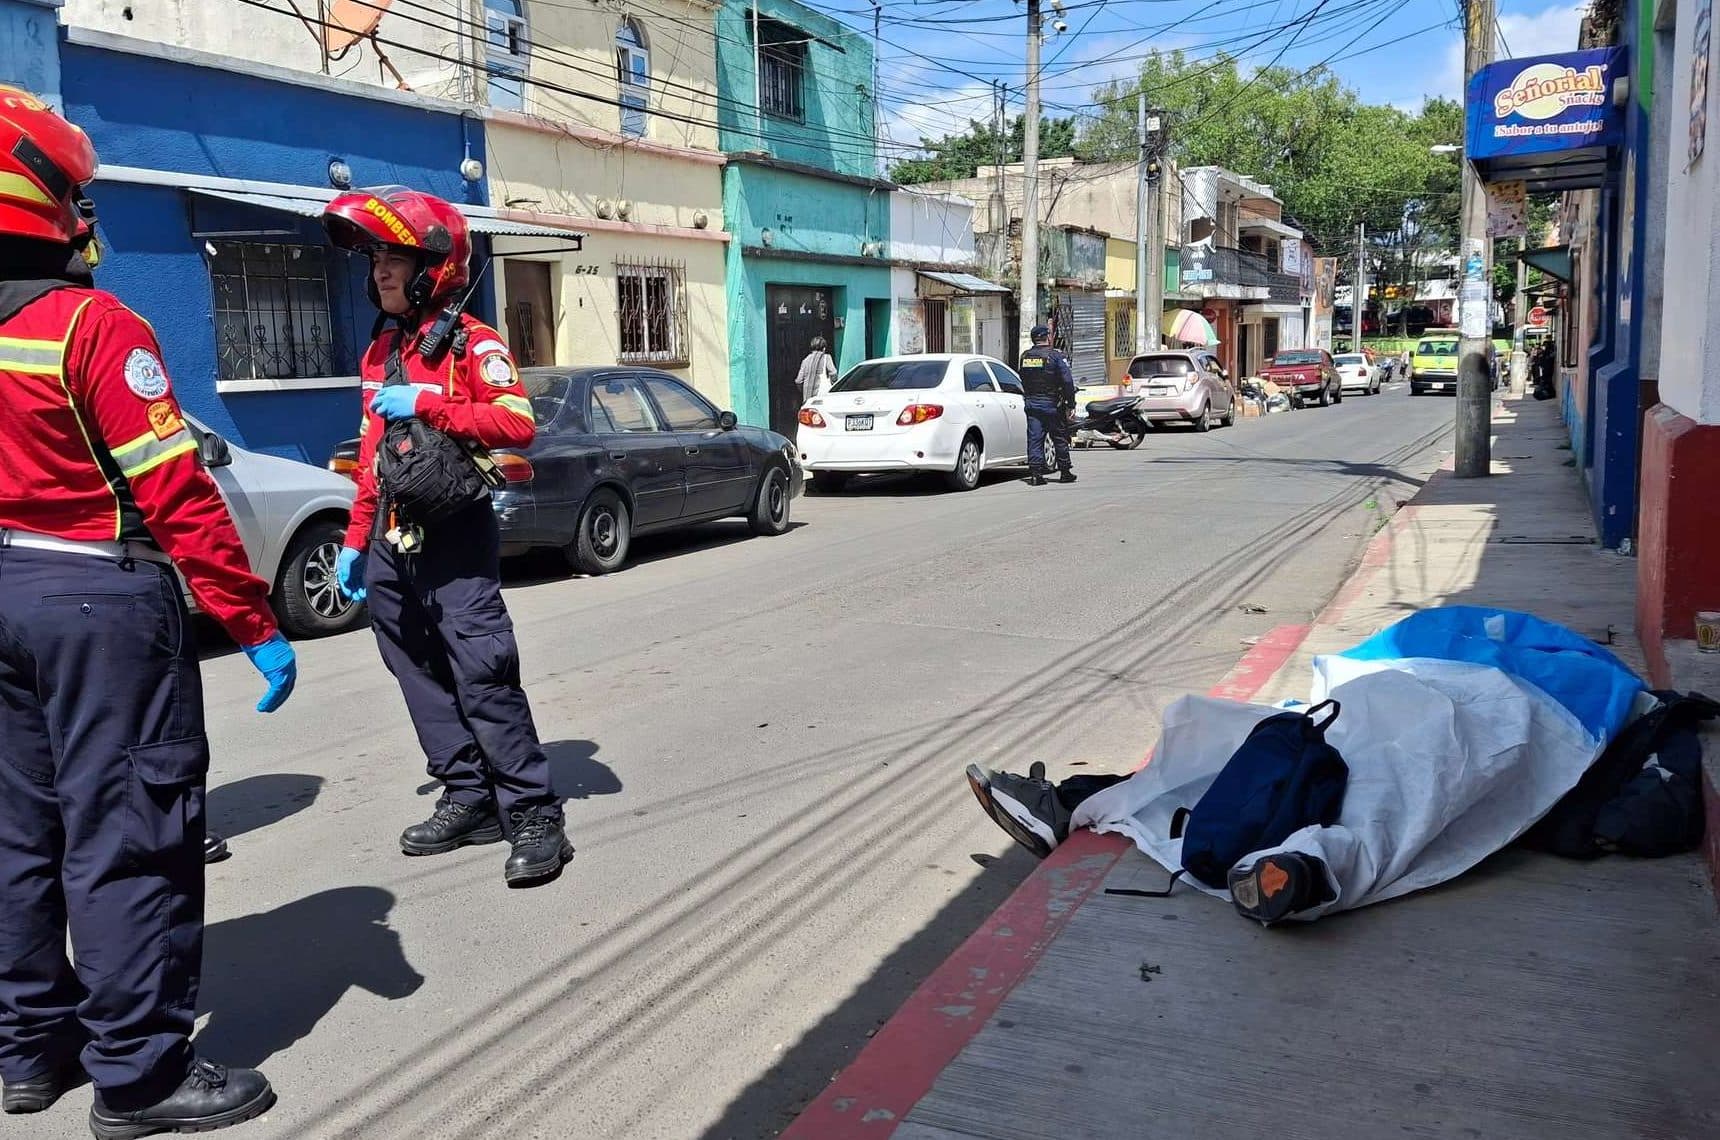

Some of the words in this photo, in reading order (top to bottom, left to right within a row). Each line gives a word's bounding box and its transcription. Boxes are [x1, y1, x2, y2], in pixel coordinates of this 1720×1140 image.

[1496, 67, 1603, 115] Señorial
[1535, 126, 1542, 135] a
[1543, 124, 1557, 134] tu
